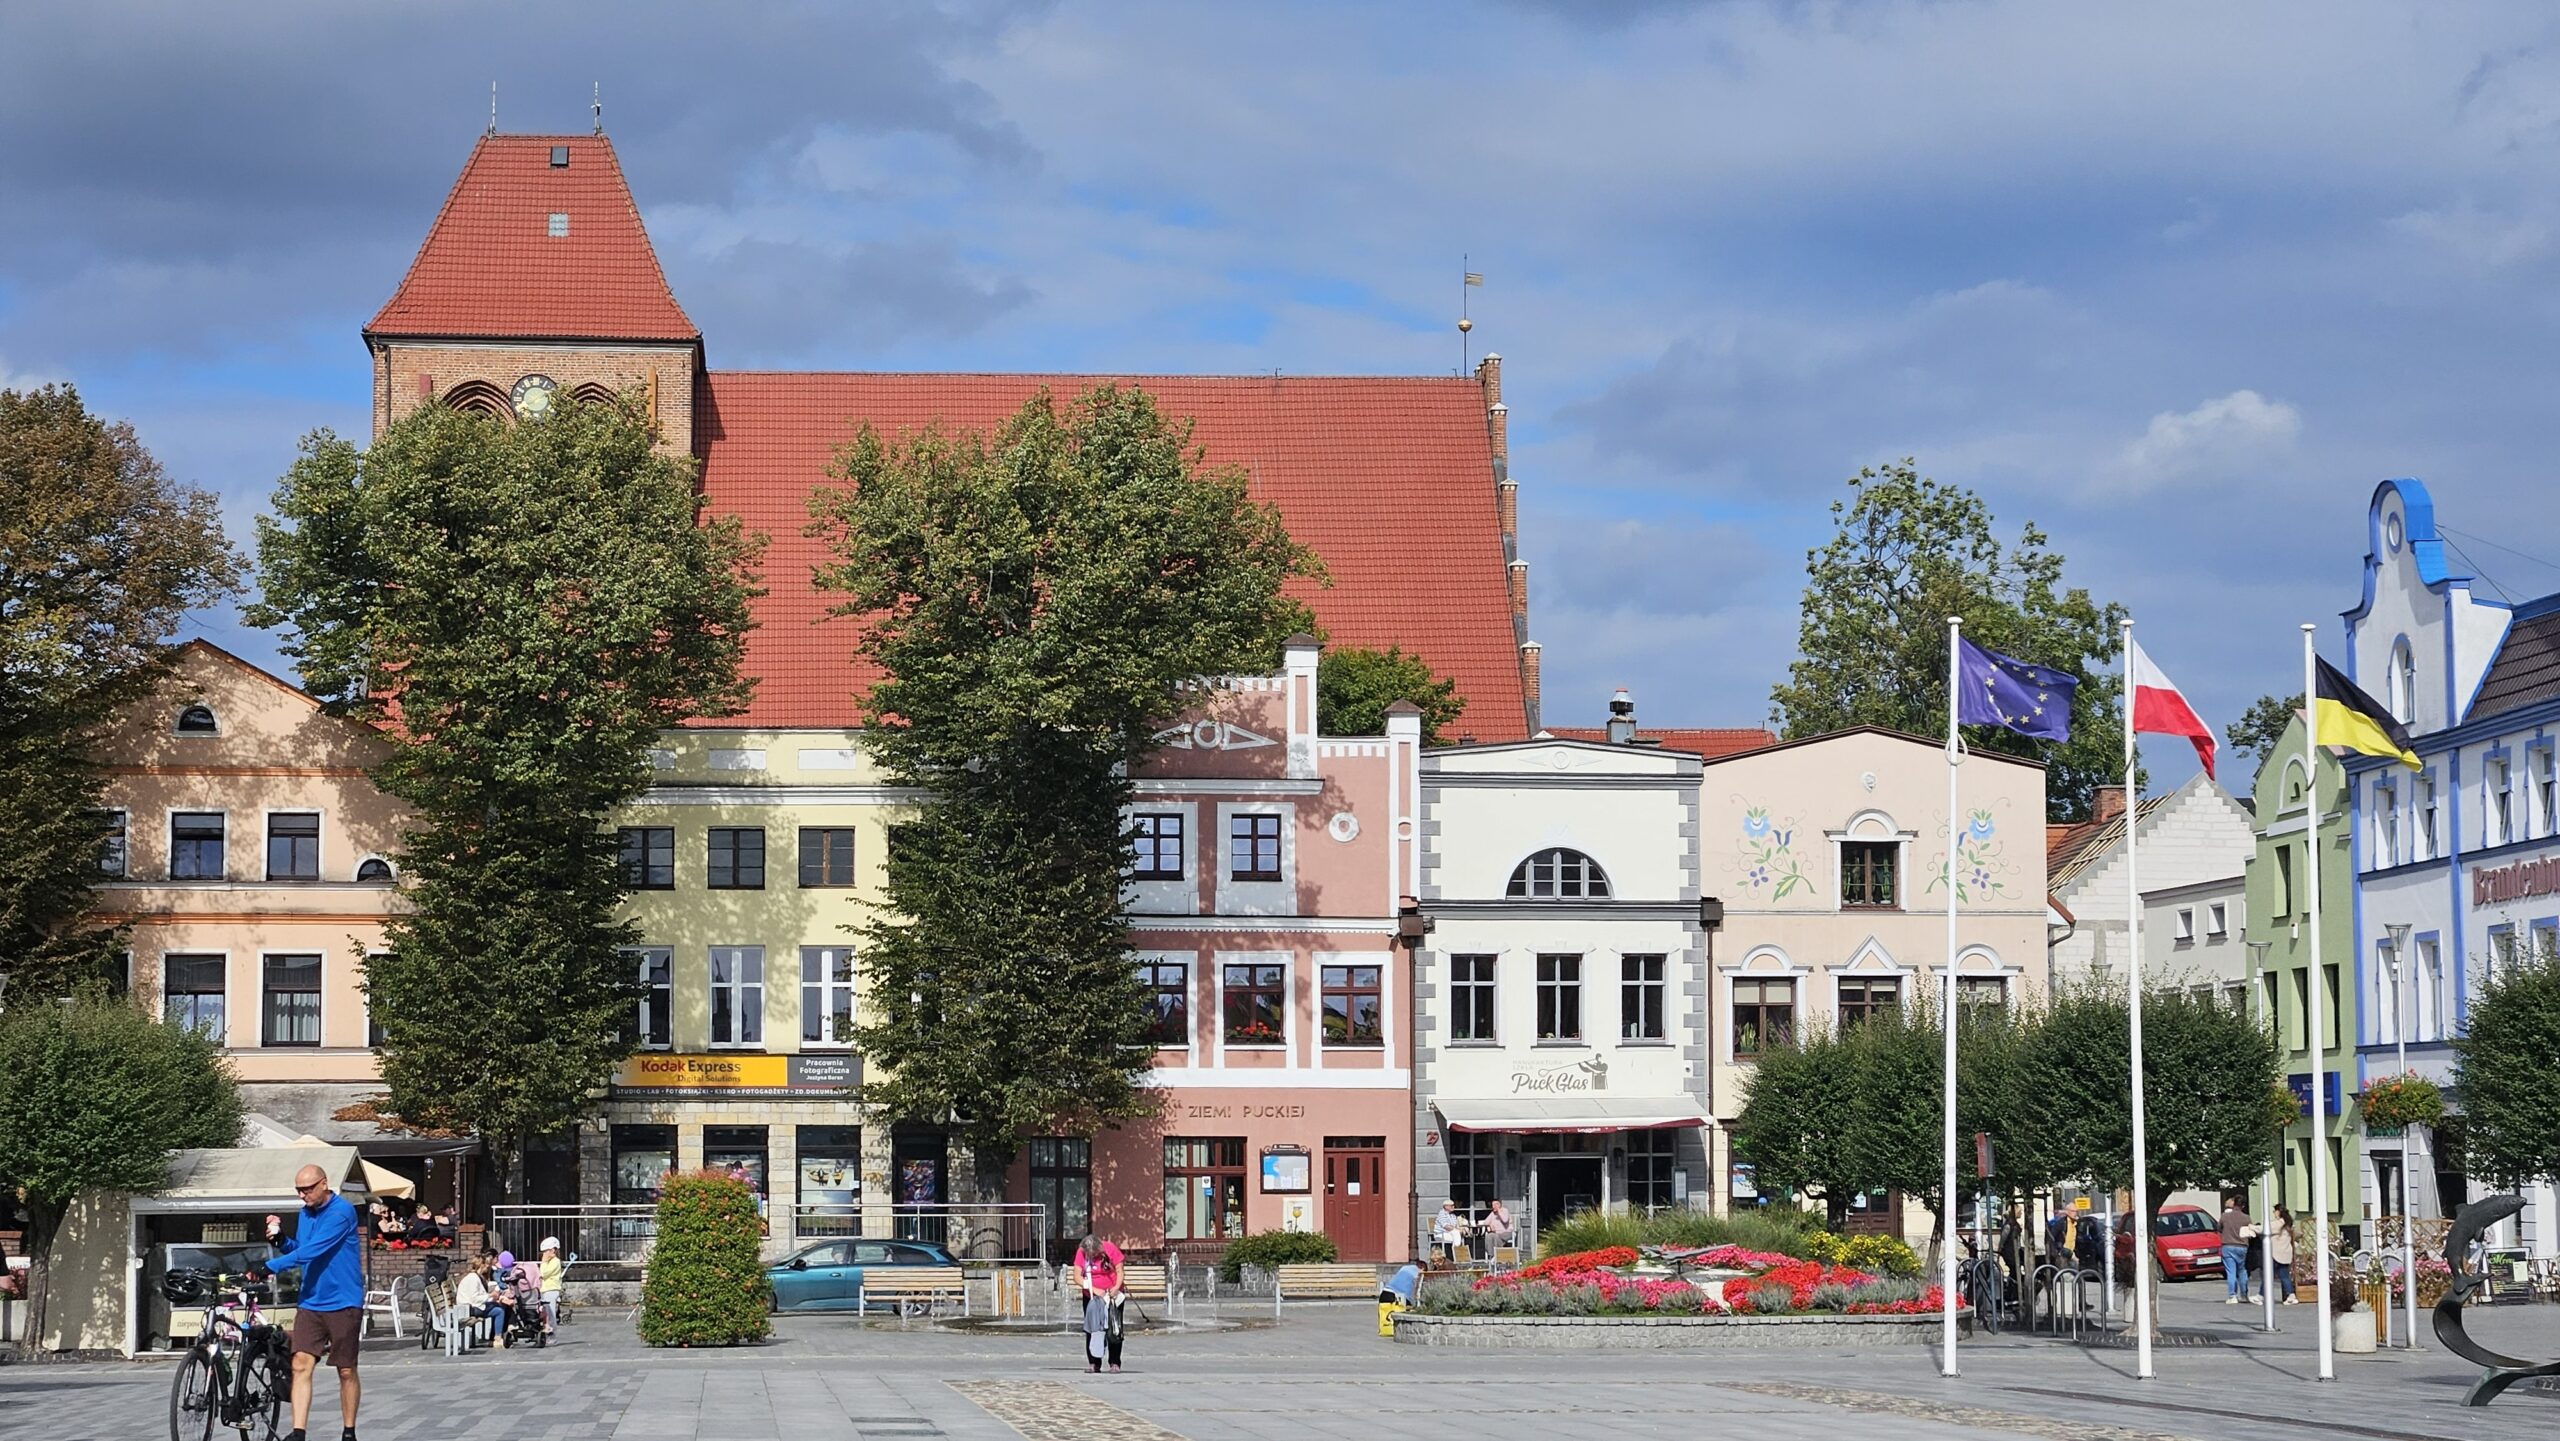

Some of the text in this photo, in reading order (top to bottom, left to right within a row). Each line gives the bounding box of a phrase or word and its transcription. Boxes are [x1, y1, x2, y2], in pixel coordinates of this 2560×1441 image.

[641, 1060, 741, 1074] Kodak Express
[799, 1067, 850, 1075] Fotograficzna
[677, 1074, 741, 1083] Digital Solutions
[1511, 1072, 1589, 1094] Puck Glas
[1188, 1106, 1232, 1118] ZIEMI
[1243, 1106, 1305, 1118] PUCKIEJ
